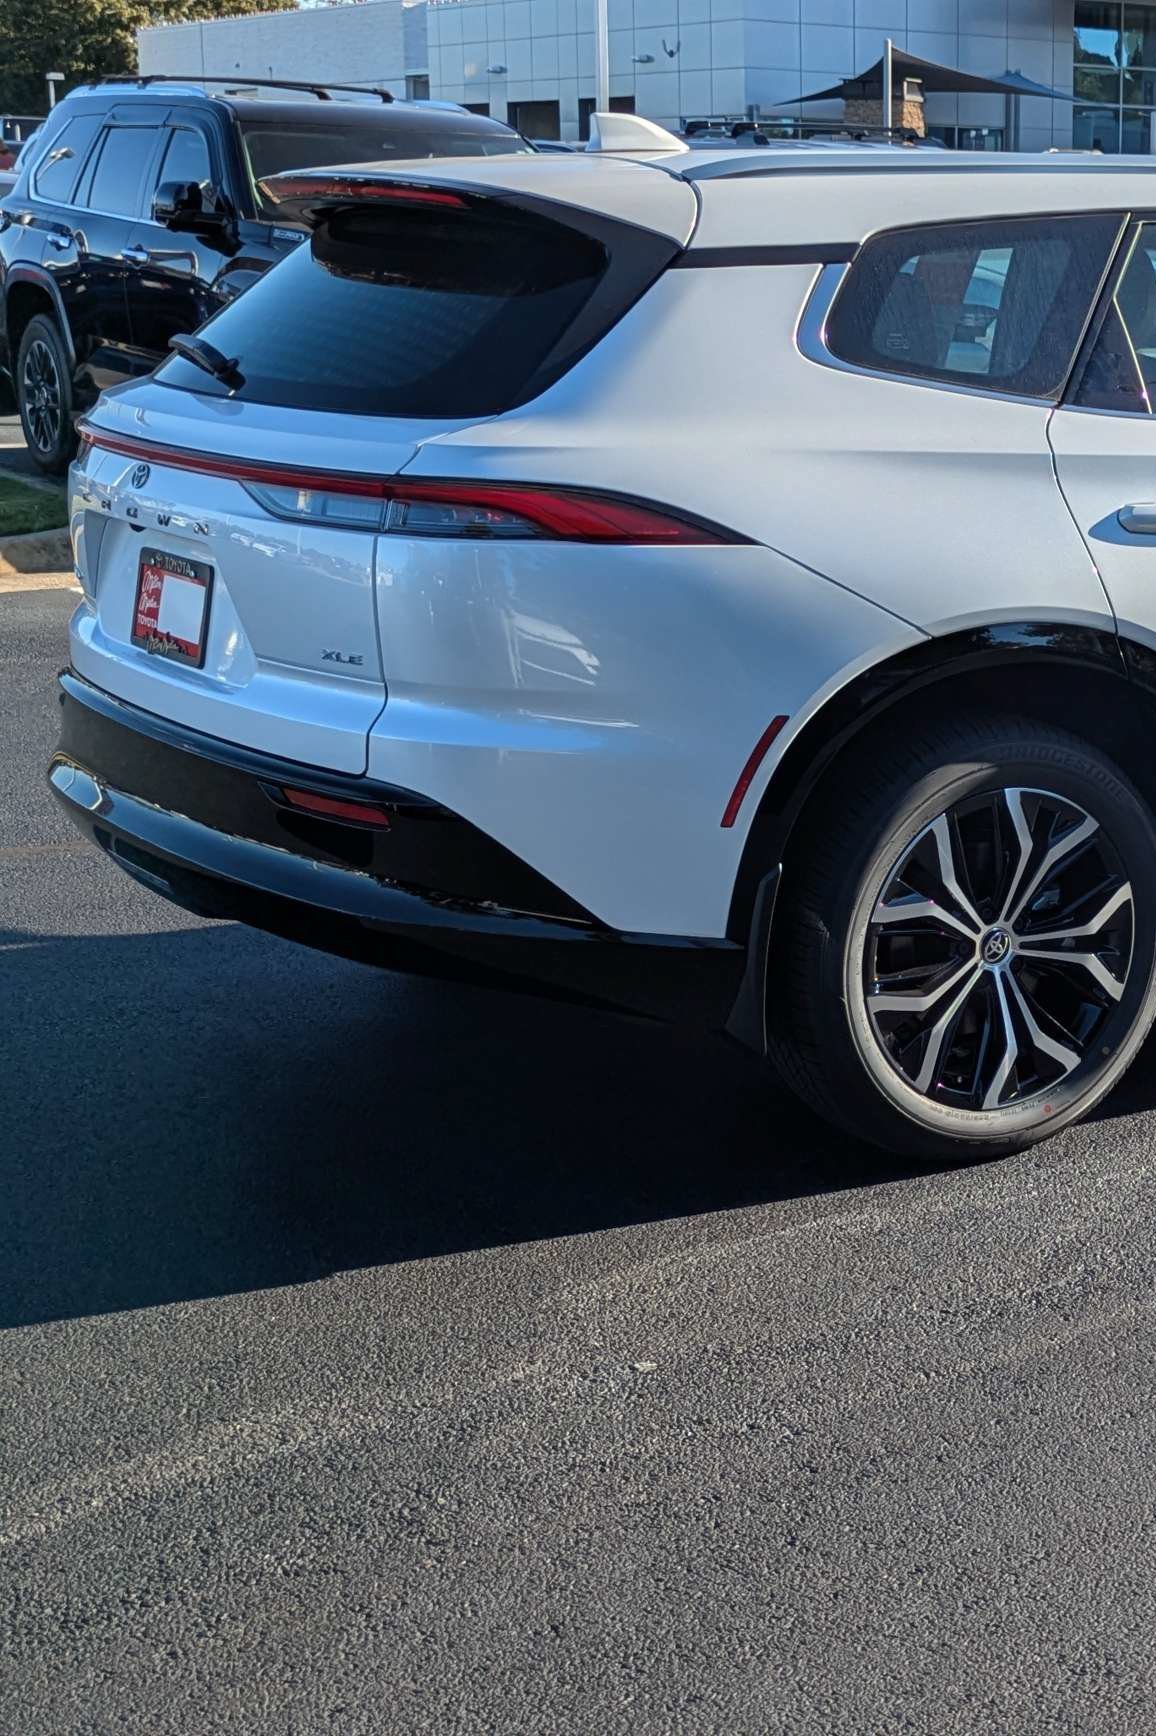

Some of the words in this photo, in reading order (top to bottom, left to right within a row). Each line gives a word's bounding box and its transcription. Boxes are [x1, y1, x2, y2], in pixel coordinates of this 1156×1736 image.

[164, 556, 191, 574] TOYOTA
[138, 614, 157, 629] TOYOTA
[320, 649, 364, 666] XLE
